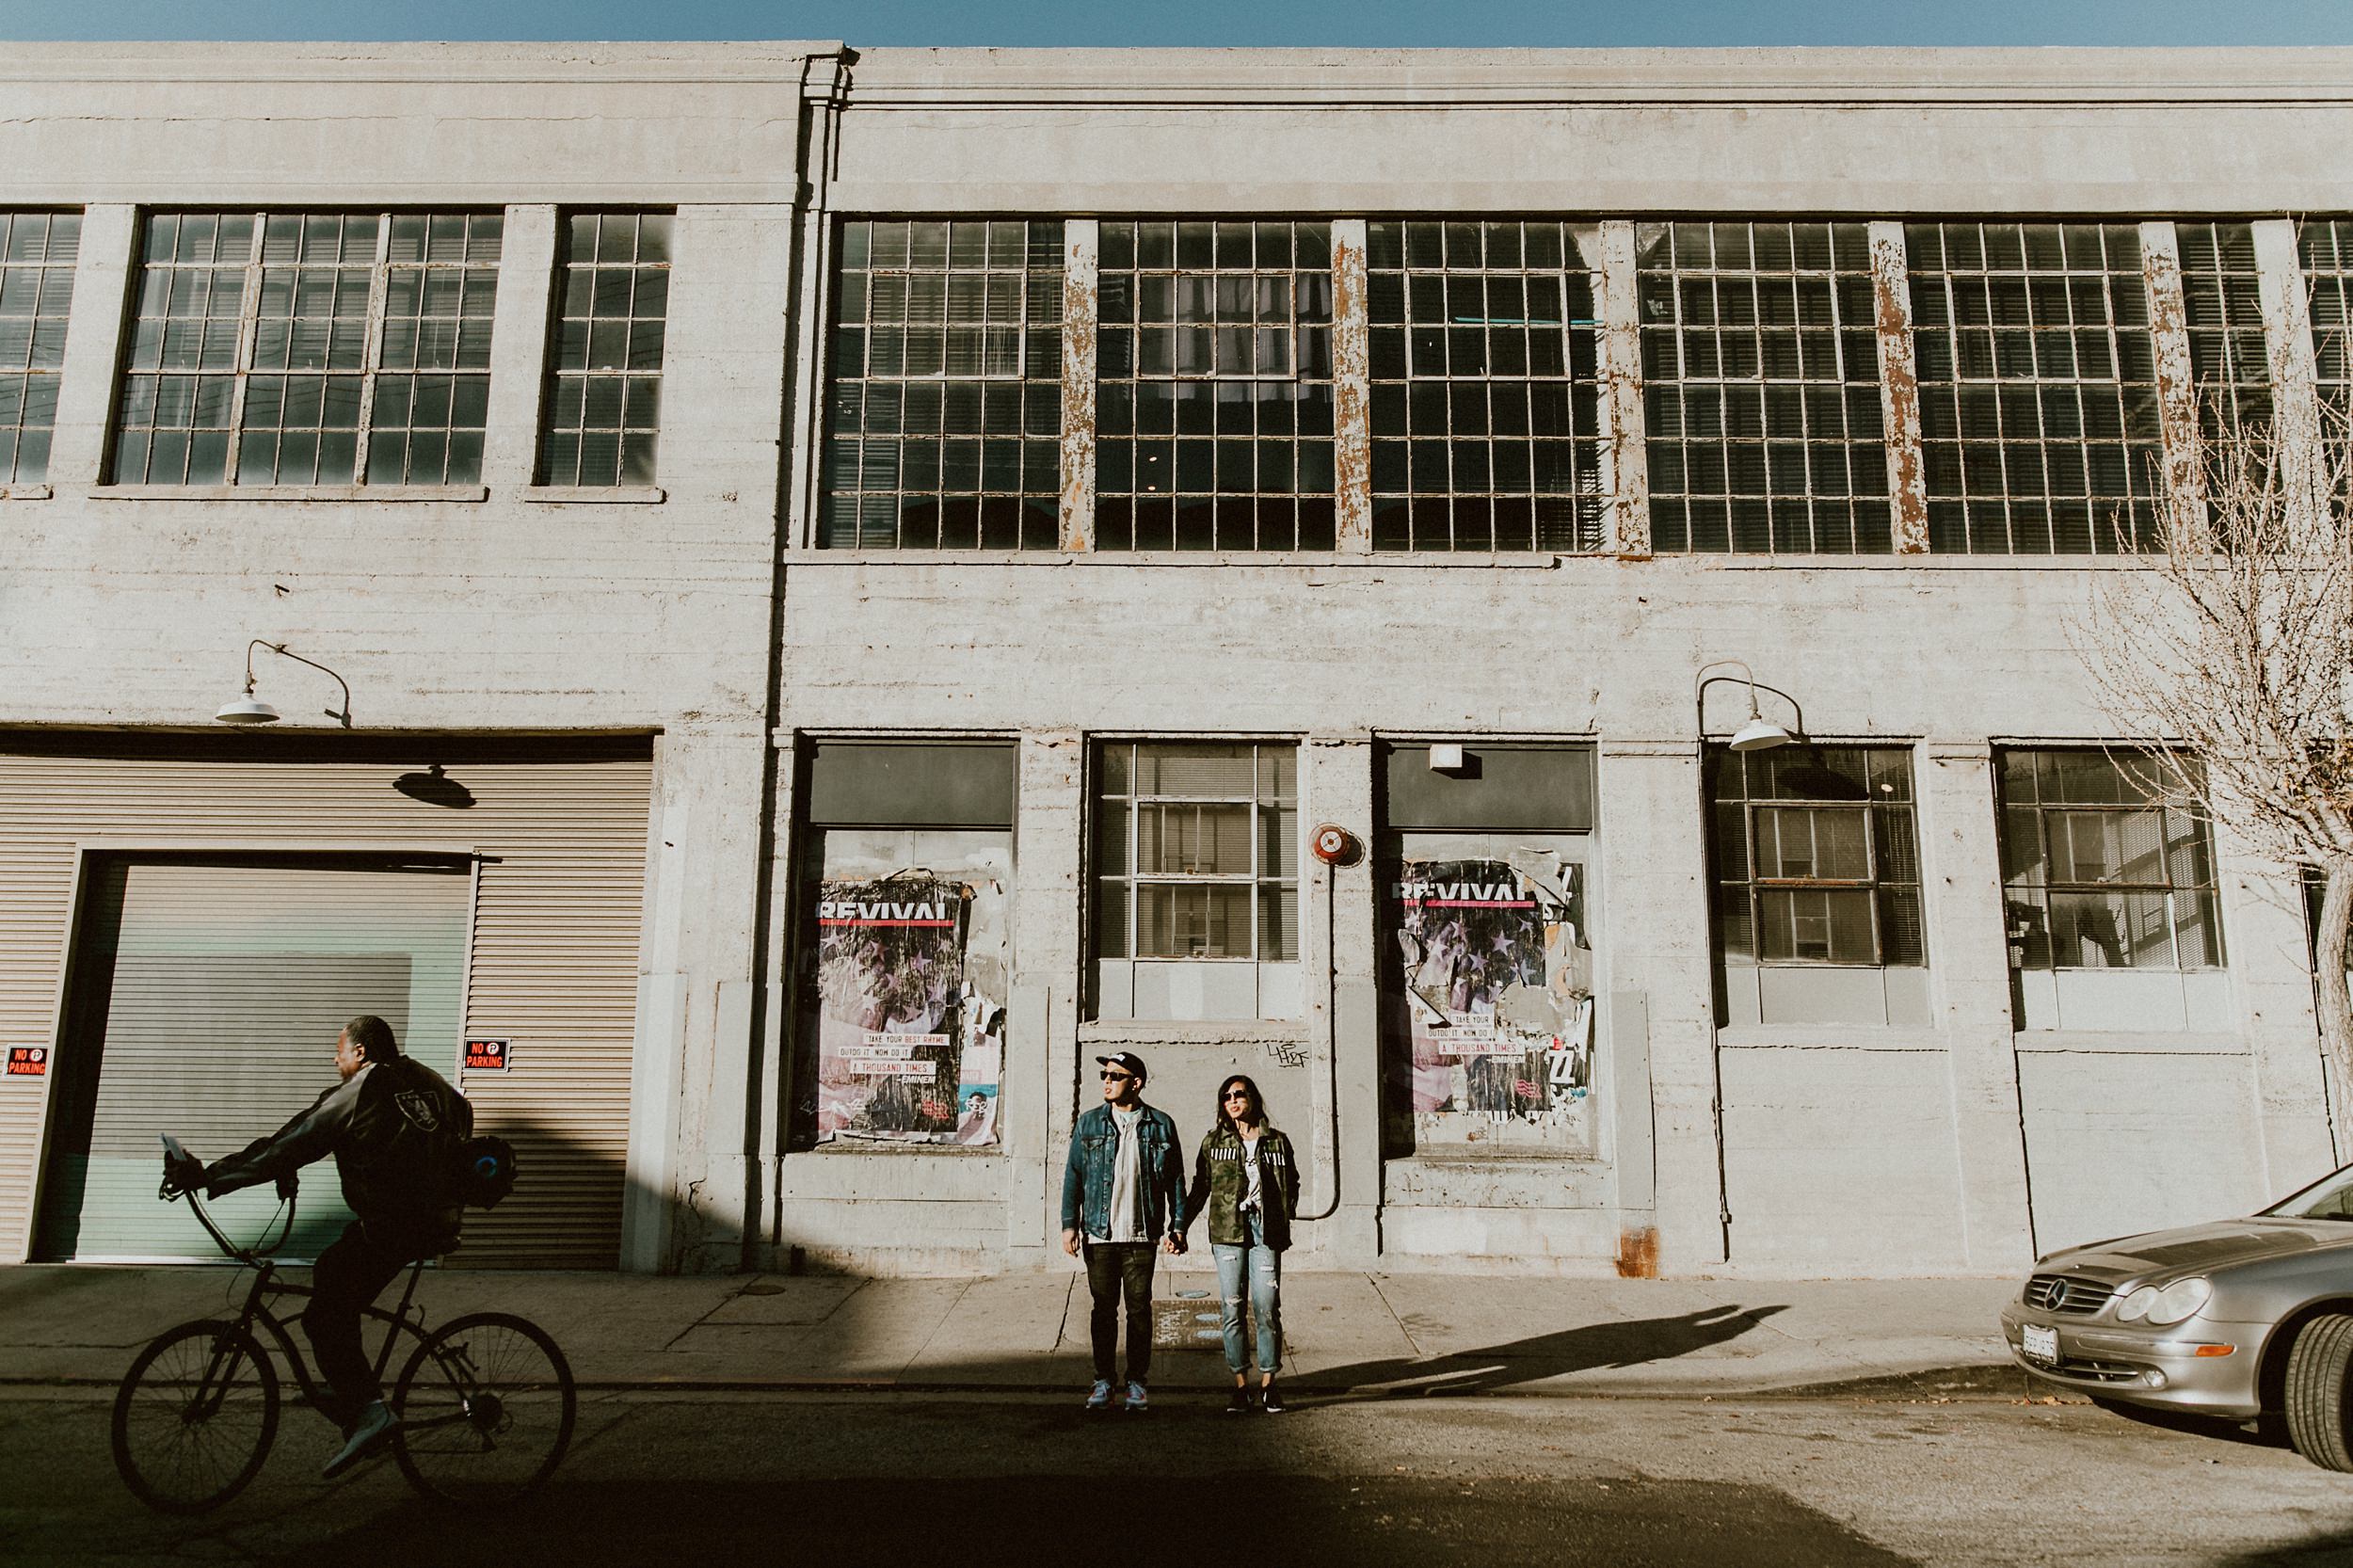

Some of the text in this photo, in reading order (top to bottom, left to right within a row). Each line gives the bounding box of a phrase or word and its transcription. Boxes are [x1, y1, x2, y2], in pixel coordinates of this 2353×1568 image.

[1473, 1016, 1489, 1024] YOUR
[887, 1035, 902, 1044] YOUR
[472, 1043, 484, 1054] NO
[1442, 1043, 1447, 1052] A
[1452, 1043, 1491, 1052] THOUSAND
[15, 1049, 27, 1061] NO
[466, 1056, 503, 1067] PARKING
[8, 1063, 45, 1075] PARKING
[862, 1064, 901, 1072] THOUSAND
